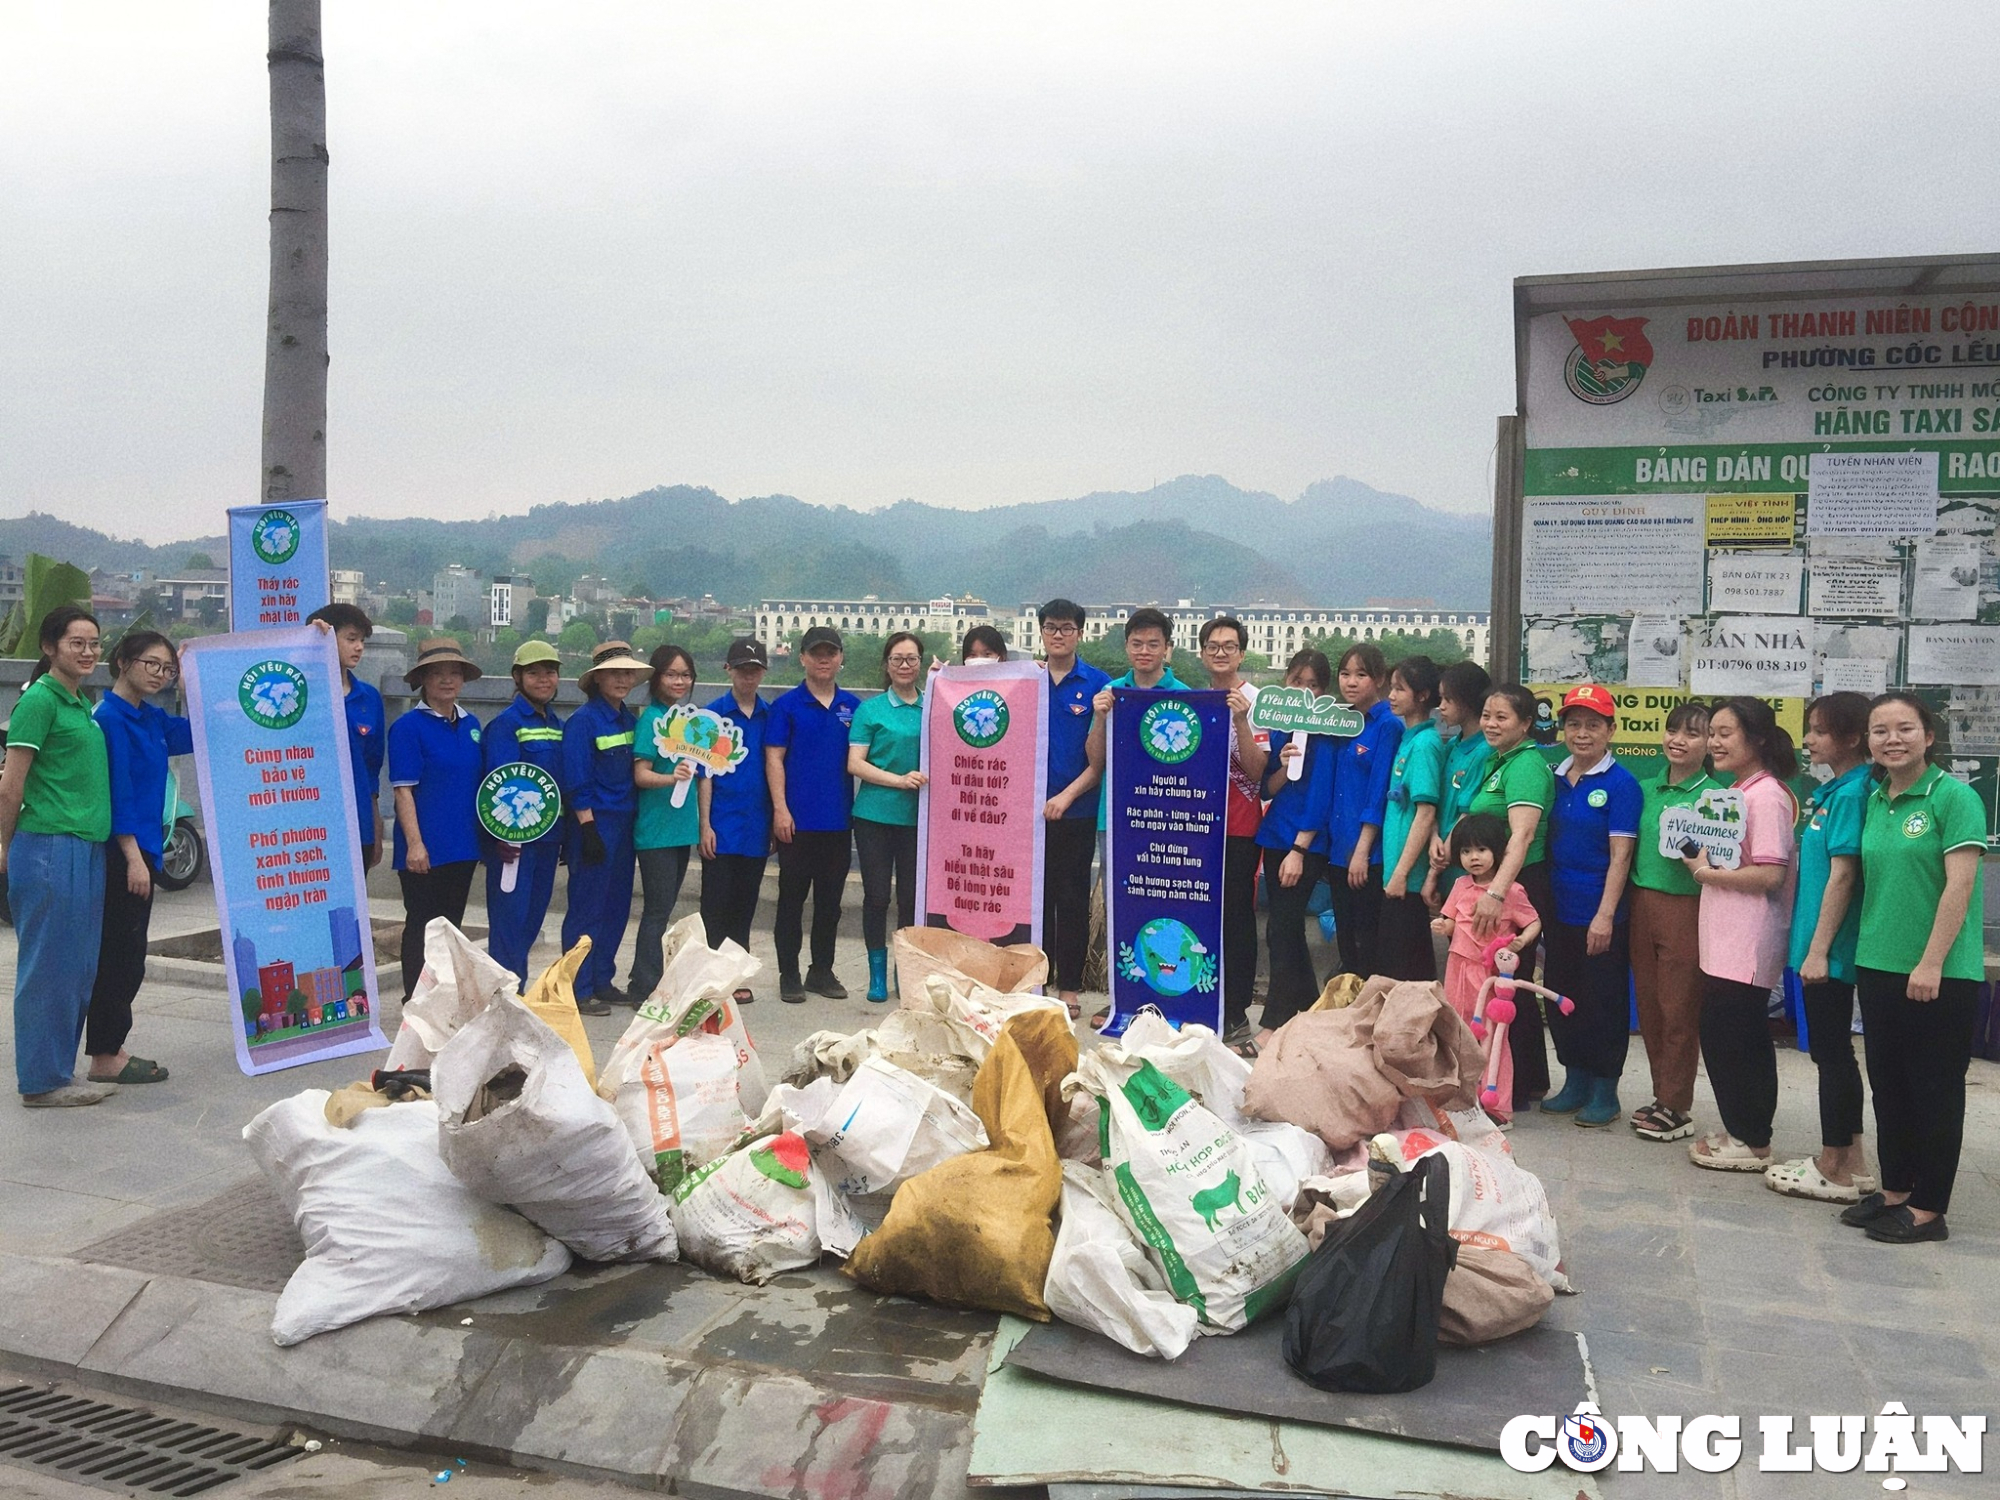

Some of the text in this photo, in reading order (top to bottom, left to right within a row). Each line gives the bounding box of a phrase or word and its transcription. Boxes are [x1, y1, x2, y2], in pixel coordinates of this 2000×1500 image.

[1687, 310, 1759, 342] ĐOÀN
[1768, 311, 1855, 339] THANH
[1865, 303, 1931, 335] NIÊN
[1762, 345, 1875, 369] PHƯỜNG
[1885, 340, 1941, 365] CỐC
[1694, 388, 1731, 403] Taxi
[1808, 383, 1867, 402] CÔNG
[1874, 385, 1901, 400] TY
[1908, 383, 1963, 400] TNHH
[1814, 406, 1890, 435] HÃNG
[1900, 407, 1961, 434] TAXI
[1635, 447, 1771, 484] BẢNG DÁN
[1864, 456, 1894, 466] NHÂN
[1898, 455, 1922, 466] VIÊN
[1949, 451, 2000, 480] RAO
[258, 575, 299, 591] Thấy rác
[1765, 572, 1776, 580] TK
[1779, 572, 1790, 580] 23
[261, 593, 297, 607] xin hãy
[284, 608, 300, 621] lên
[1755, 629, 1806, 649] NHÀ
[1697, 659, 1807, 671] ĐT:0796 038 319
[242, 671, 258, 690] HỘI
[1261, 693, 1302, 708] #Yêu Rác
[1272, 711, 1292, 724] lòng
[1294, 713, 1303, 723] ta
[1305, 713, 1321, 725] sâu
[1323, 712, 1338, 727] sắc
[1339, 717, 1357, 728] hơn
[1621, 717, 1659, 732] Taxi
[244, 745, 315, 765] Cùng nhau
[1616, 745, 1657, 757] CHÓNG
[954, 754, 1007, 771] Chiếc rác
[262, 765, 306, 783] bảo vệ
[951, 772, 1009, 789] từ đâu tới?
[1152, 774, 1177, 787] Người
[485, 770, 508, 791] HỘI
[537, 775, 556, 800] RÁC
[1134, 785, 1147, 796] xin
[1165, 787, 1191, 799] chung
[1193, 788, 1207, 800] tay
[249, 784, 320, 806] môi trường
[960, 789, 998, 807] Rồi rác
[951, 807, 1007, 825] đi về đâu?
[1126, 806, 1142, 818] Rác
[1130, 819, 1145, 829] cho
[1146, 821, 1167, 832] ngay
[1168, 822, 1184, 832] vào
[1667, 818, 1739, 840] #Vietnamese
[250, 826, 327, 848] Phố phường
[256, 850, 291, 869] xanh
[961, 844, 995, 861] Ta hãy
[944, 858, 1014, 879] hiểu thật sâu
[1162, 856, 1182, 867] lung
[1183, 857, 1202, 868] tung
[256, 867, 330, 891] tình thương
[963, 879, 987, 896] lòng
[989, 884, 1010, 897] yêu
[1129, 874, 1143, 886] Quê
[1145, 875, 1171, 888] hương
[1172, 878, 1193, 891] sạch
[265, 887, 328, 911] ngập tràn
[954, 896, 1002, 914] được rác
